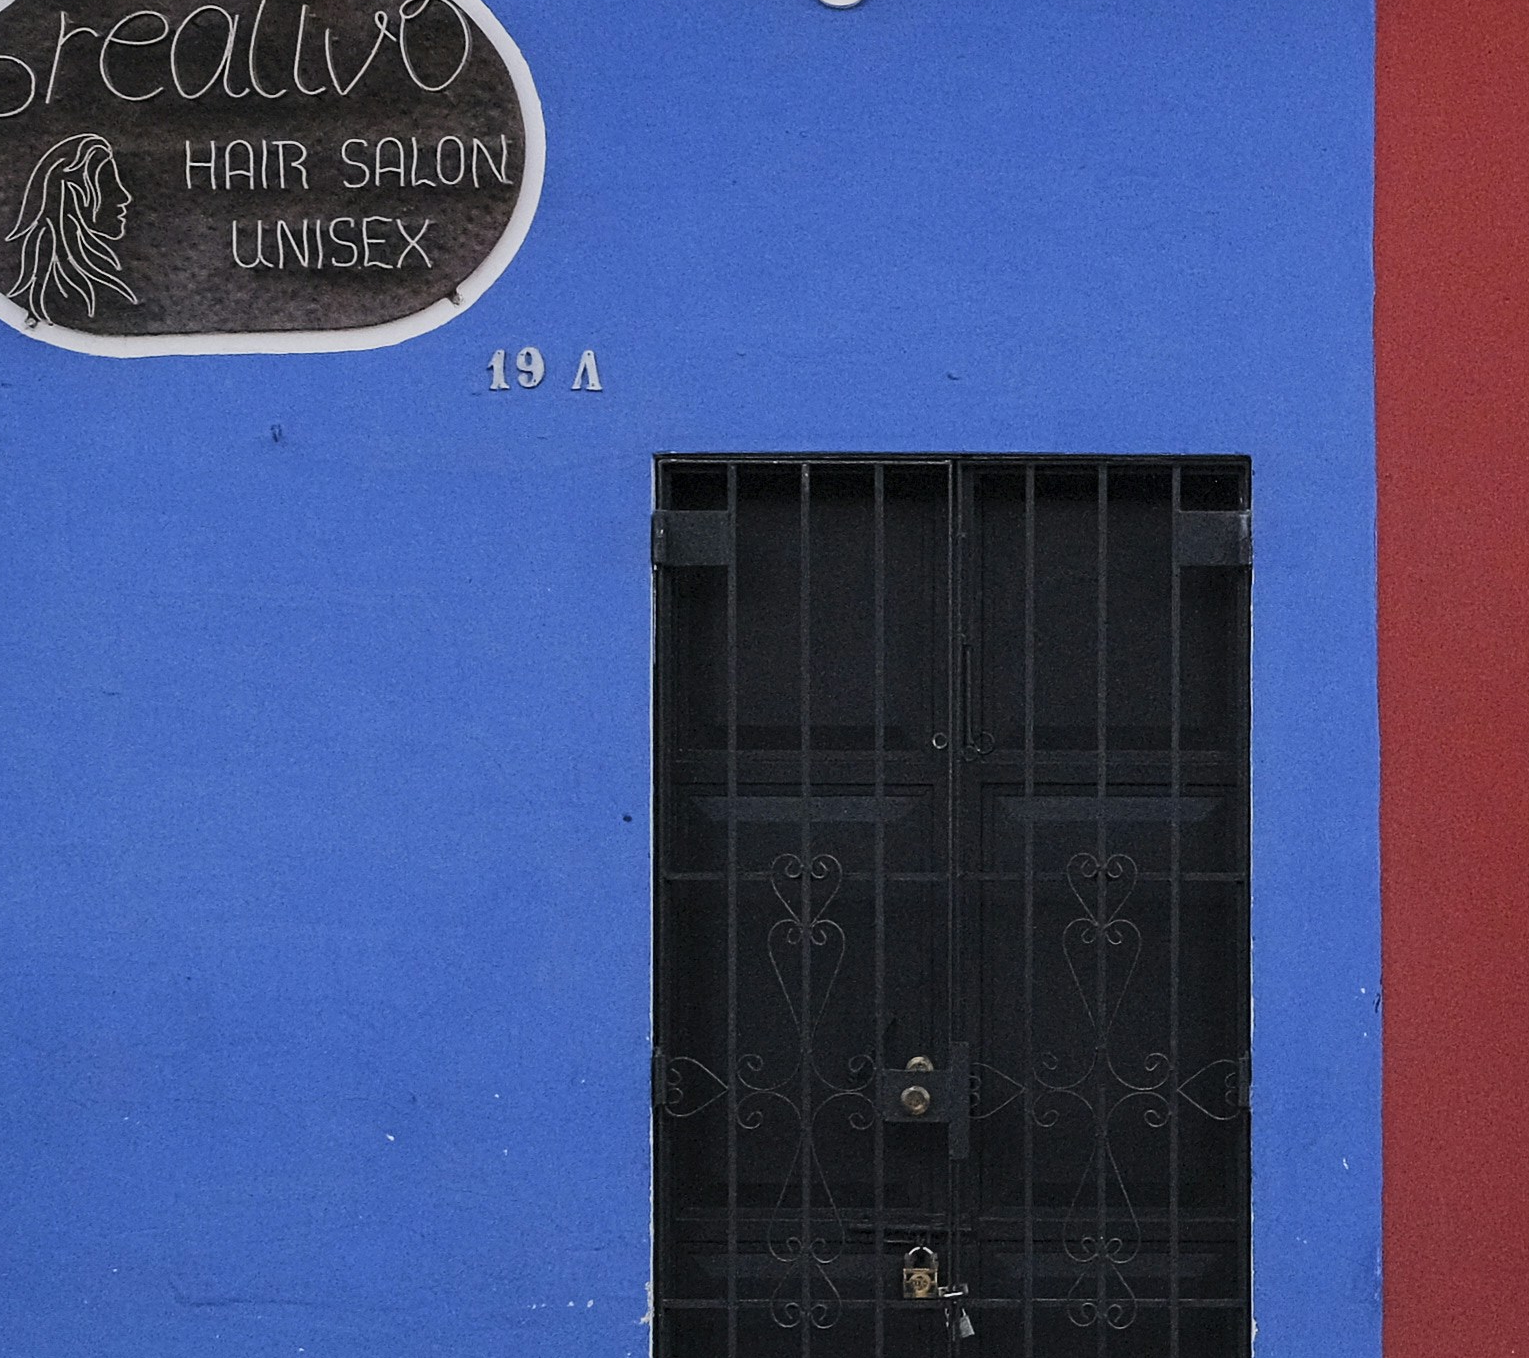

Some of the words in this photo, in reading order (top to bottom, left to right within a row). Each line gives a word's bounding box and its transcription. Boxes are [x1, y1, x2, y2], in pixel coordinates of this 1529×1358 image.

[185, 139, 309, 190] HAIR
[341, 134, 514, 189] SALON
[232, 217, 433, 269] UNISEX
[486, 346, 547, 392] 19
